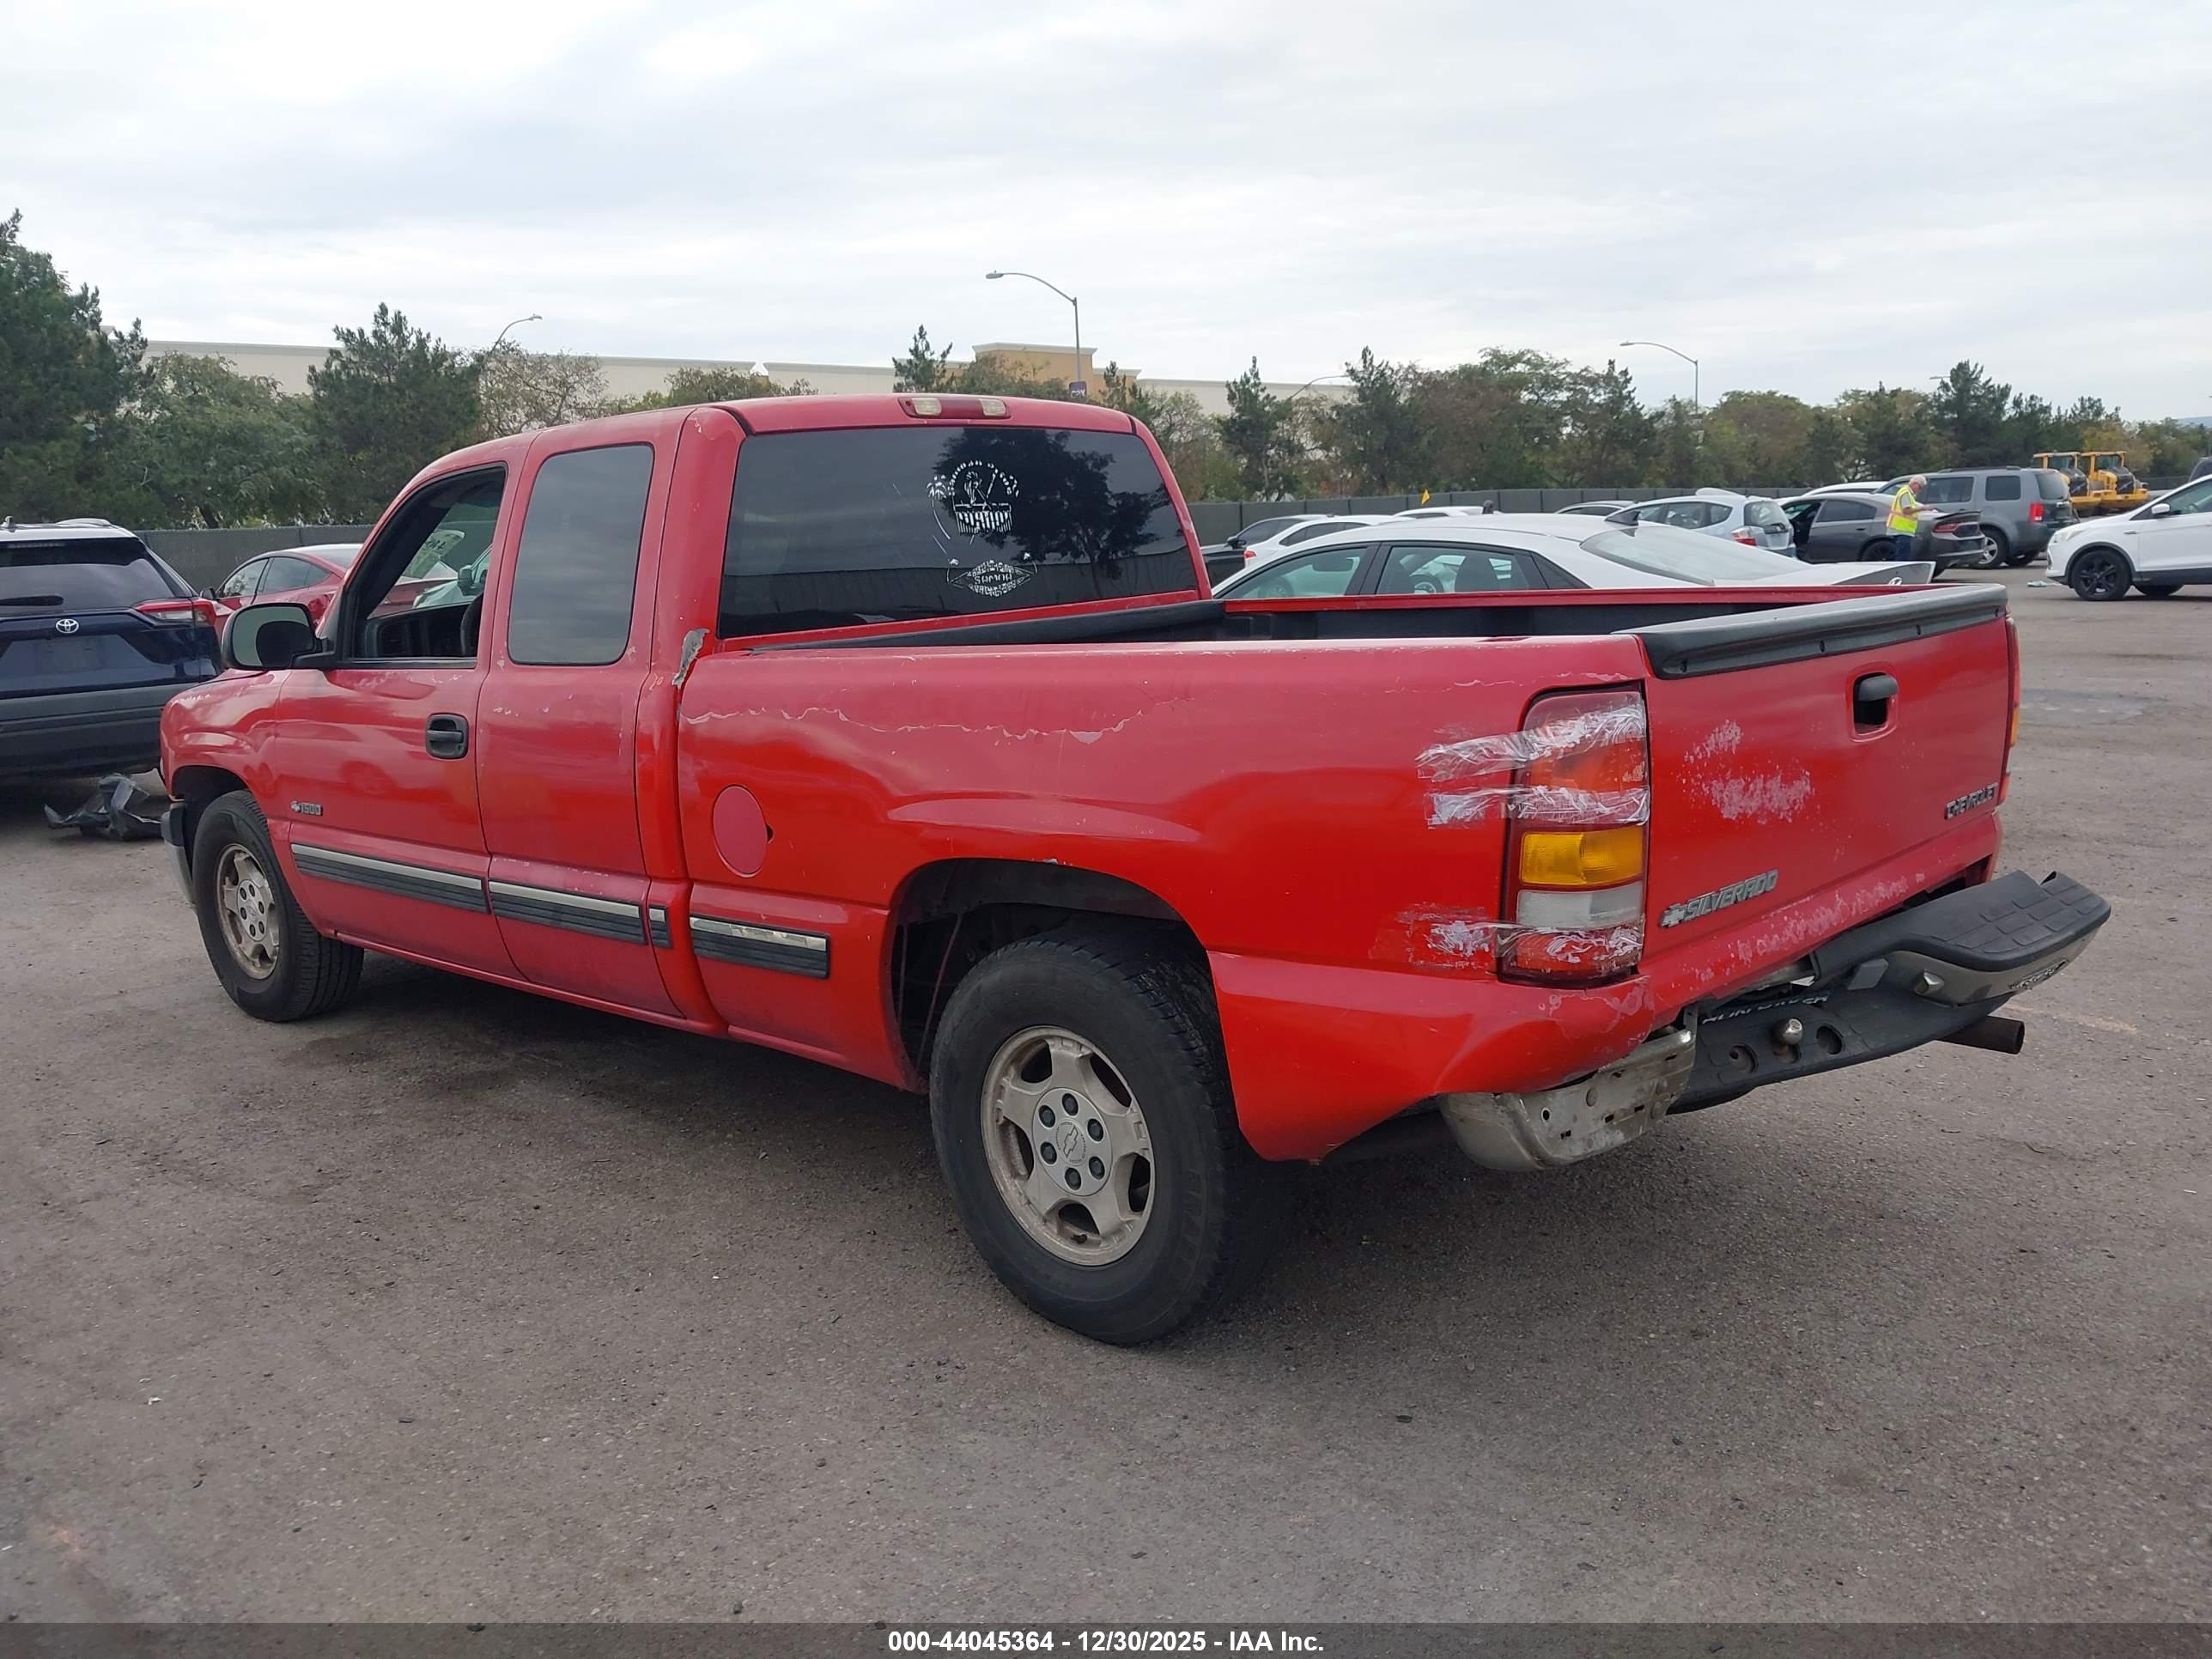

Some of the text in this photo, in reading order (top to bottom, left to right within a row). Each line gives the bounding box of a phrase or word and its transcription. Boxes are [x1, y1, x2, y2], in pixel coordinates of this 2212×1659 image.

[301, 802, 322, 816] 1500
[1946, 781, 1998, 819] CHEVROLET
[1685, 869, 1778, 921] SILVERADO
